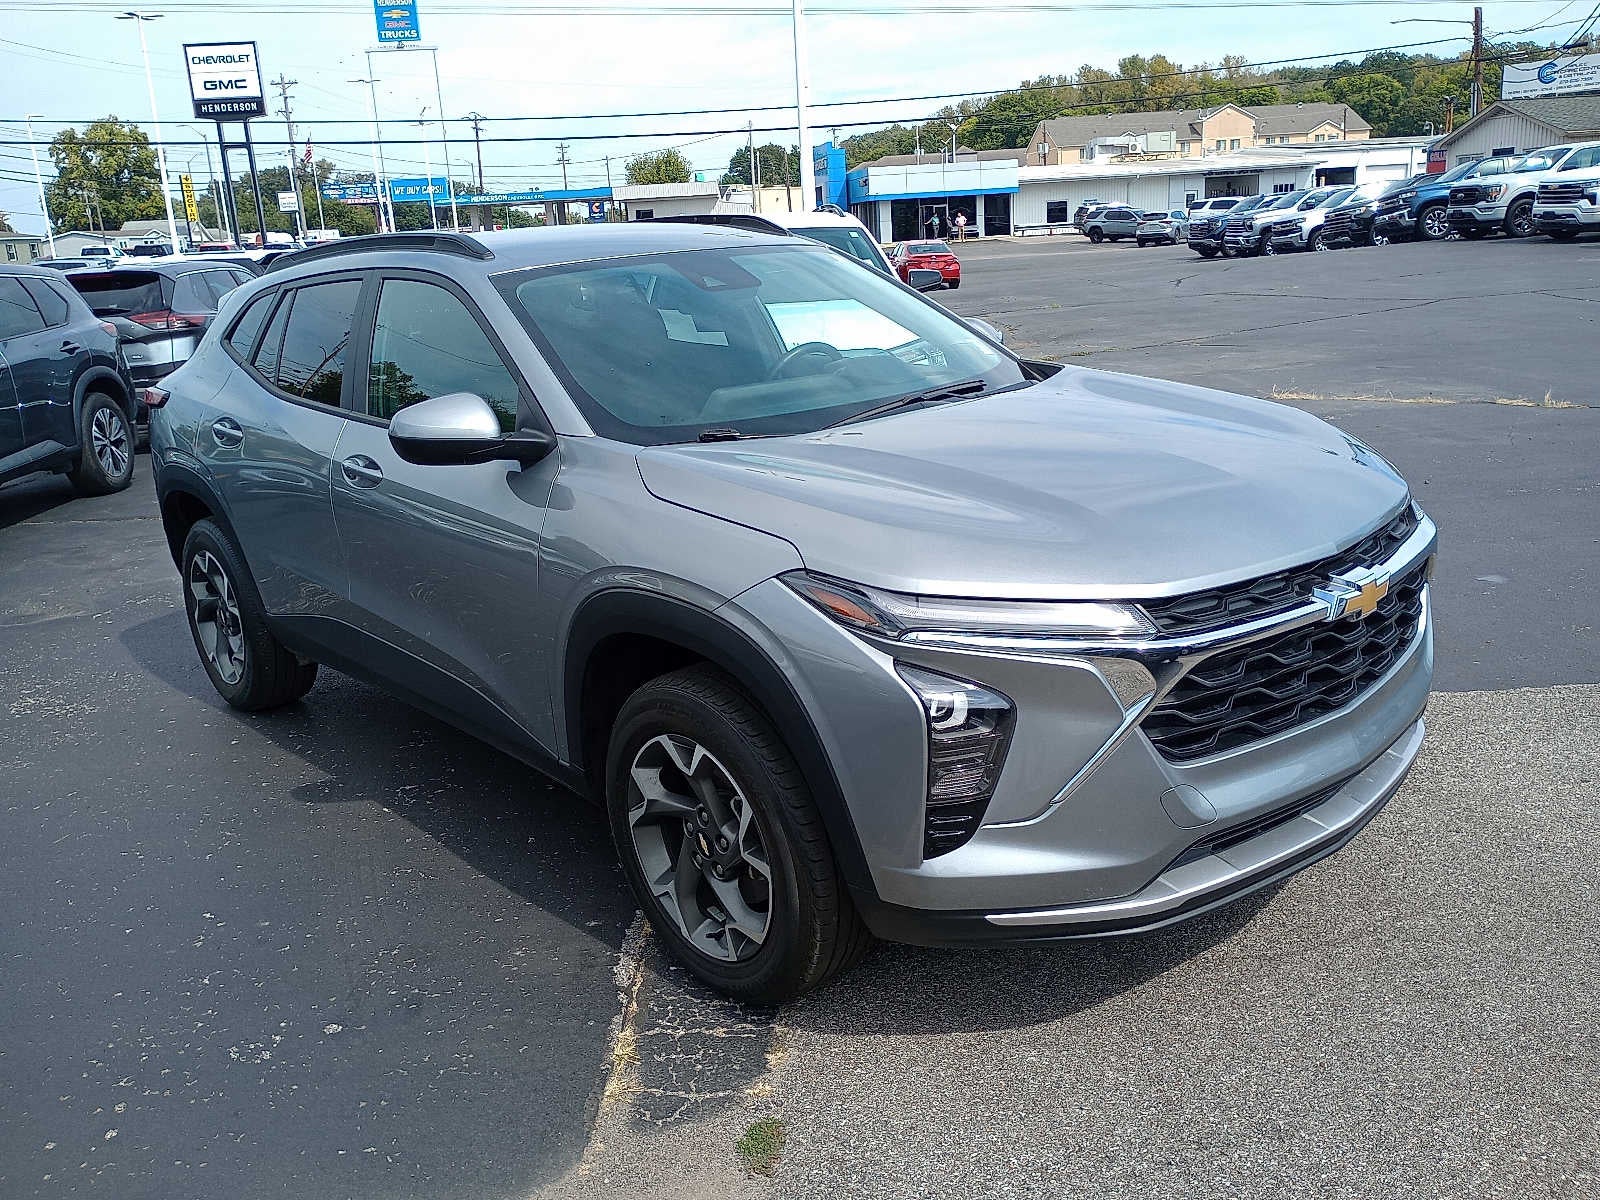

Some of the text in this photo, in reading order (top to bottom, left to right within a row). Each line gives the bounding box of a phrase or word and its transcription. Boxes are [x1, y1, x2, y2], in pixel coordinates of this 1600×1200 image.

[380, 30, 417, 39] TRUCKS
[192, 54, 250, 64] CHEVROLET
[204, 79, 247, 90] GMC
[201, 102, 257, 112] HENDERSON
[394, 186, 404, 195] WE
[406, 186, 420, 195] BUY
[470, 195, 507, 203] HENDERSON
